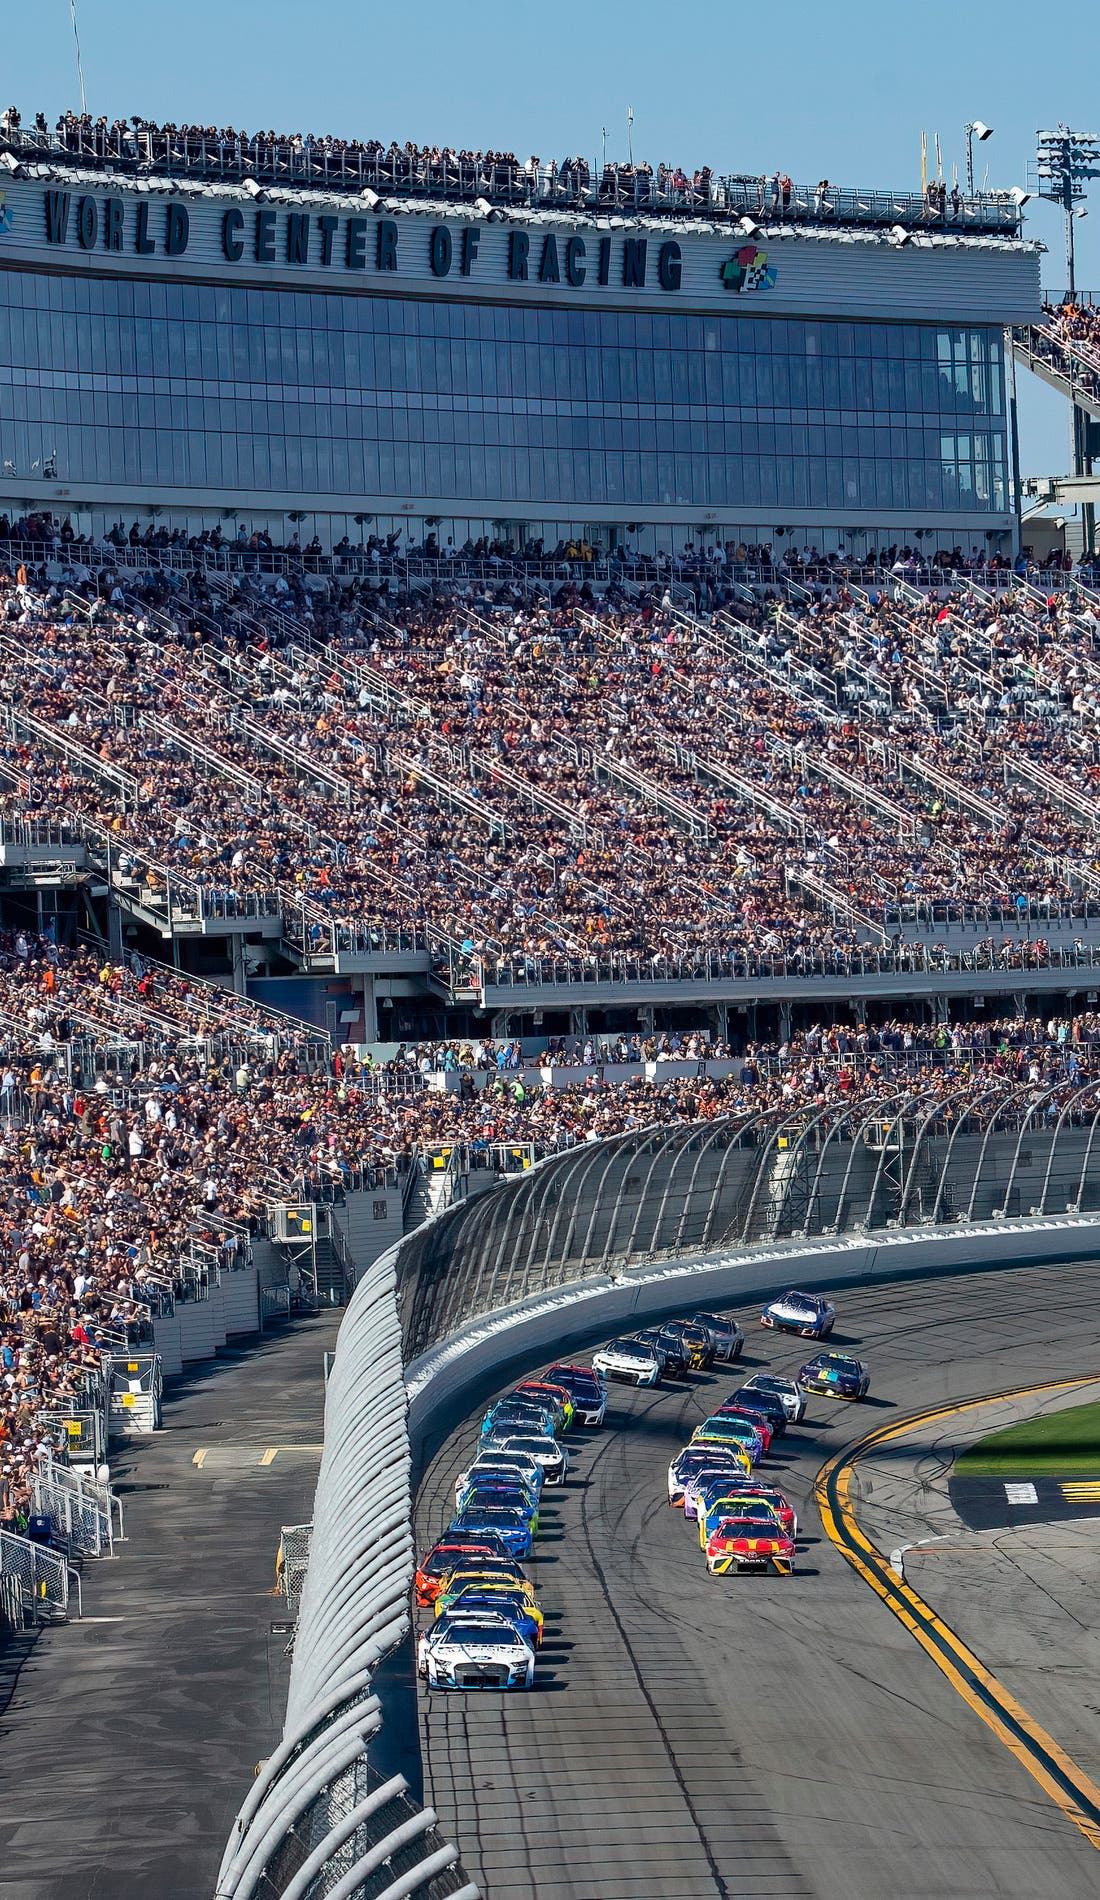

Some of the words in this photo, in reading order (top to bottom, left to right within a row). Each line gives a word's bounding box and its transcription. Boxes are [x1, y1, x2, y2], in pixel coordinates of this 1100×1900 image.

[46, 190, 190, 256] WORLD
[223, 208, 398, 271] CENTER
[431, 225, 481, 278] OF
[509, 230, 682, 291] RACING
